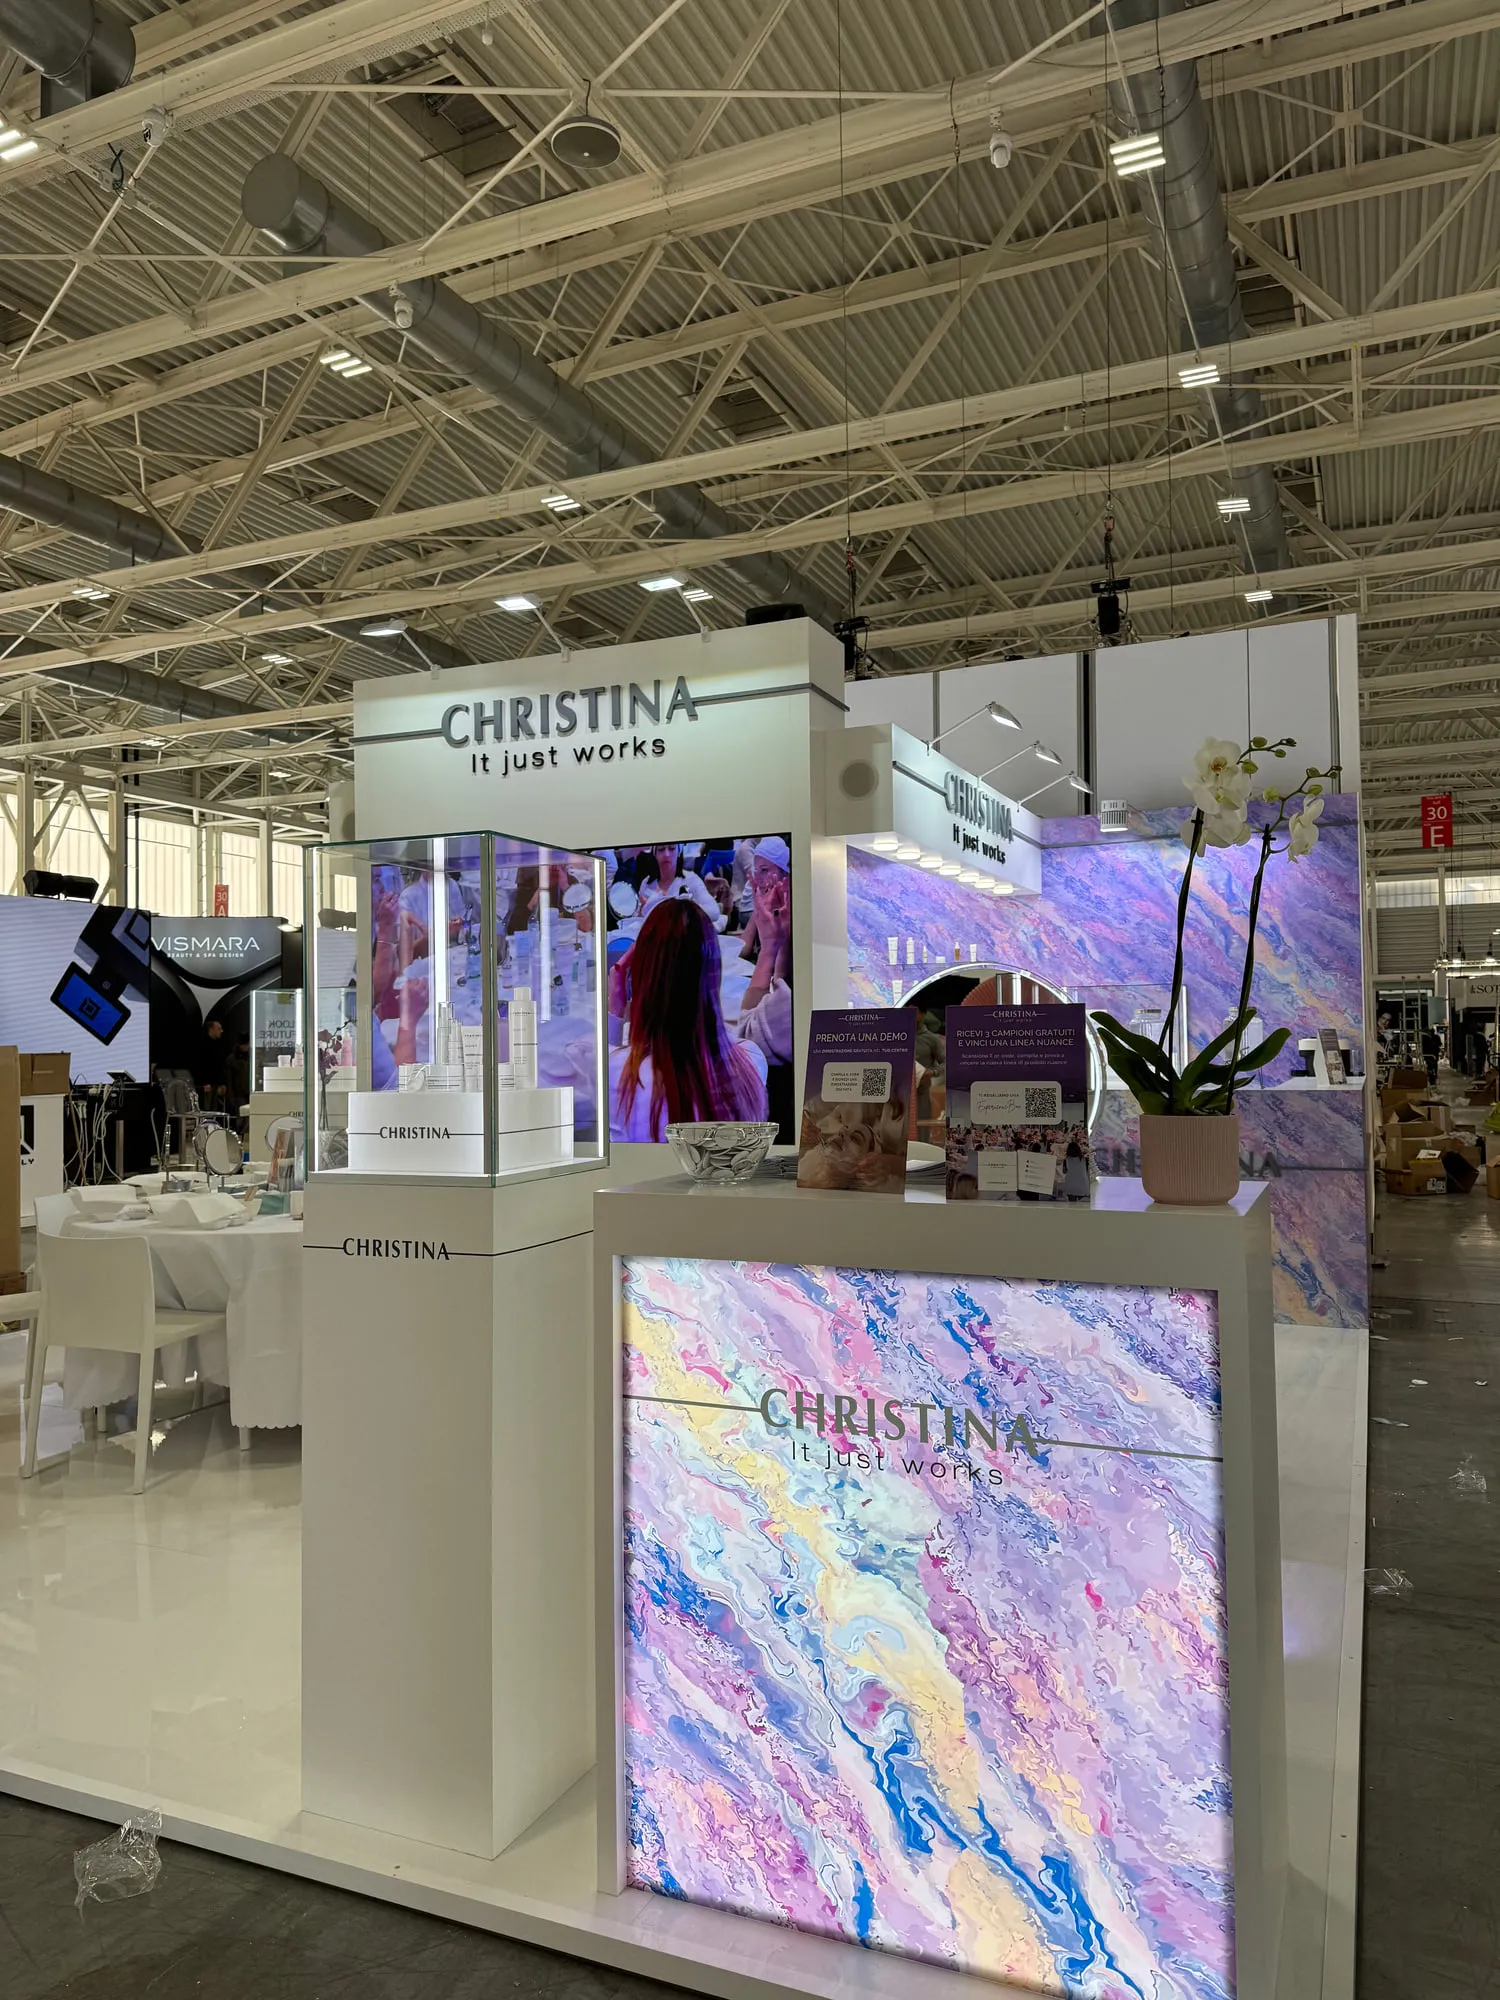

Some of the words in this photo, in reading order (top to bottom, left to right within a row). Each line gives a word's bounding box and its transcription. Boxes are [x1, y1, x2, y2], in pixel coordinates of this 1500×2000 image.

[442, 676, 698, 748] CHRISTINA
[471, 752, 490, 773] It
[502, 746, 559, 777] just
[573, 736, 667, 764] works
[944, 771, 1014, 844] CHRISTINA
[1427, 806, 1448, 821] 30
[1430, 825, 1445, 847] E
[953, 823, 961, 844] It
[962, 828, 980, 853] just
[982, 842, 1006, 865] works
[216, 891, 228, 902] 30
[217, 904, 226, 917] A
[150, 936, 260, 951] VISMARA
[844, 1014, 879, 1022] CHRISTINA
[993, 1010, 1037, 1018] CHRISTINA
[816, 1033, 857, 1042] PRENOTA
[858, 1032, 878, 1042] UNA
[880, 1032, 908, 1041] DEMO
[957, 1030, 983, 1038] RICEVI
[991, 1029, 1034, 1037] CAMPIONI
[1035, 1028, 1076, 1037] GRATUITI
[958, 1039, 963, 1047] E
[964, 1039, 988, 1047] VINCI
[989, 1039, 1008, 1047] UNA
[1010, 1039, 1035, 1047] LINEA
[1036, 1038, 1075, 1046] NUANCE
[379, 1126, 451, 1140] CHRISTINA
[343, 1237, 450, 1261] CHRISTINA
[760, 1388, 1039, 1457] CHRISTINA
[792, 1441, 810, 1462] It
[825, 1445, 885, 1470] just
[902, 1458, 1003, 1485] works
